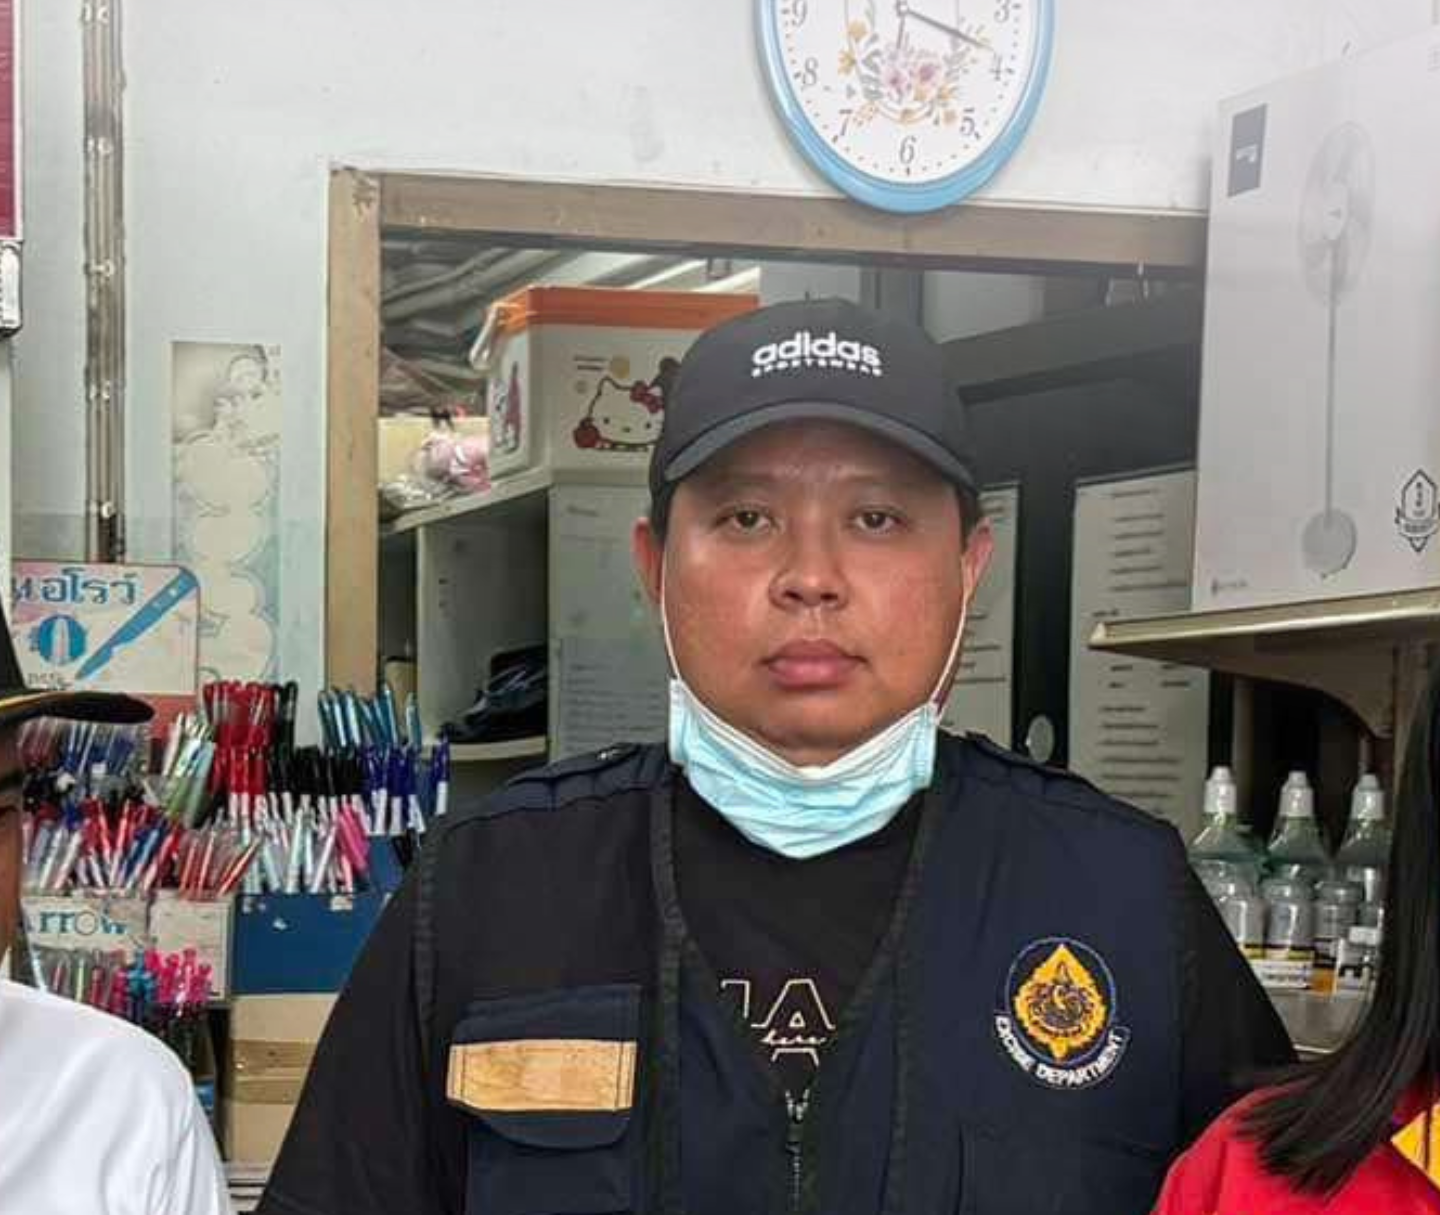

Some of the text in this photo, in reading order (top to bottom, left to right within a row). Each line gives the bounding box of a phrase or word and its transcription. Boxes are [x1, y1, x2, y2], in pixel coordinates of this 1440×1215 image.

[791, 0, 807, 27] 9
[994, 0, 1009, 23] 3
[801, 57, 819, 87] 8
[989, 53, 1003, 80] 4
[839, 108, 853, 136] 7
[960, 107, 976, 136] 5
[900, 136, 915, 164] 6
[751, 331, 883, 367] adidas
[40, 566, 138, 606] อโรว์
[1035, 1029, 1124, 1087] DEPARTMENT
